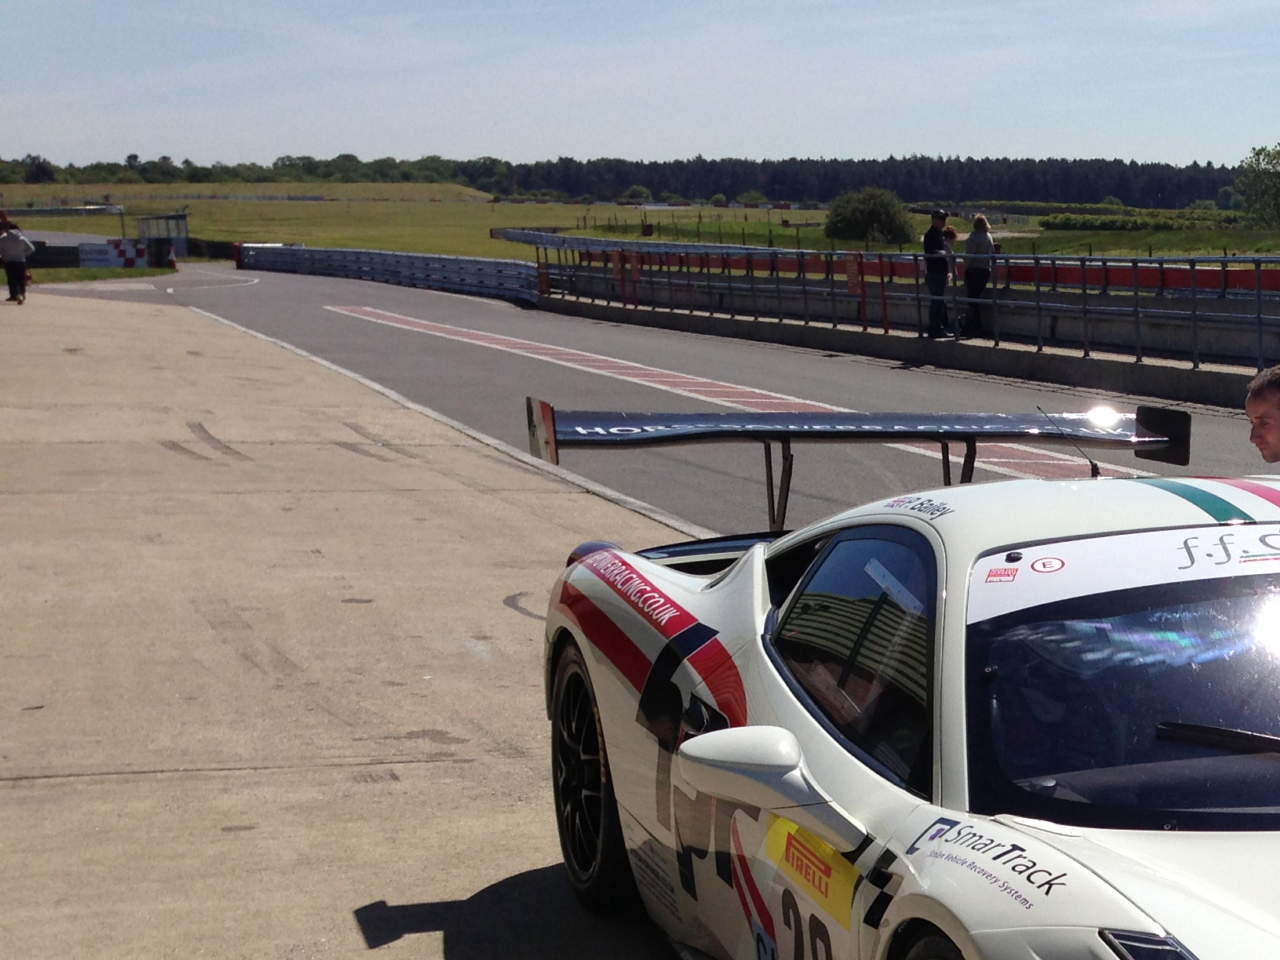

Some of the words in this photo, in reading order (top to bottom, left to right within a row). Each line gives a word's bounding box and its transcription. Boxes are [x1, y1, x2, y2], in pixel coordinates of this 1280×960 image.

[909, 499, 955, 521] Bailey
[785, 831, 832, 899] PIRELLI
[944, 853, 969, 867] Vehicle
[966, 861, 1000, 885] Recovery
[998, 881, 1034, 911] Systems
